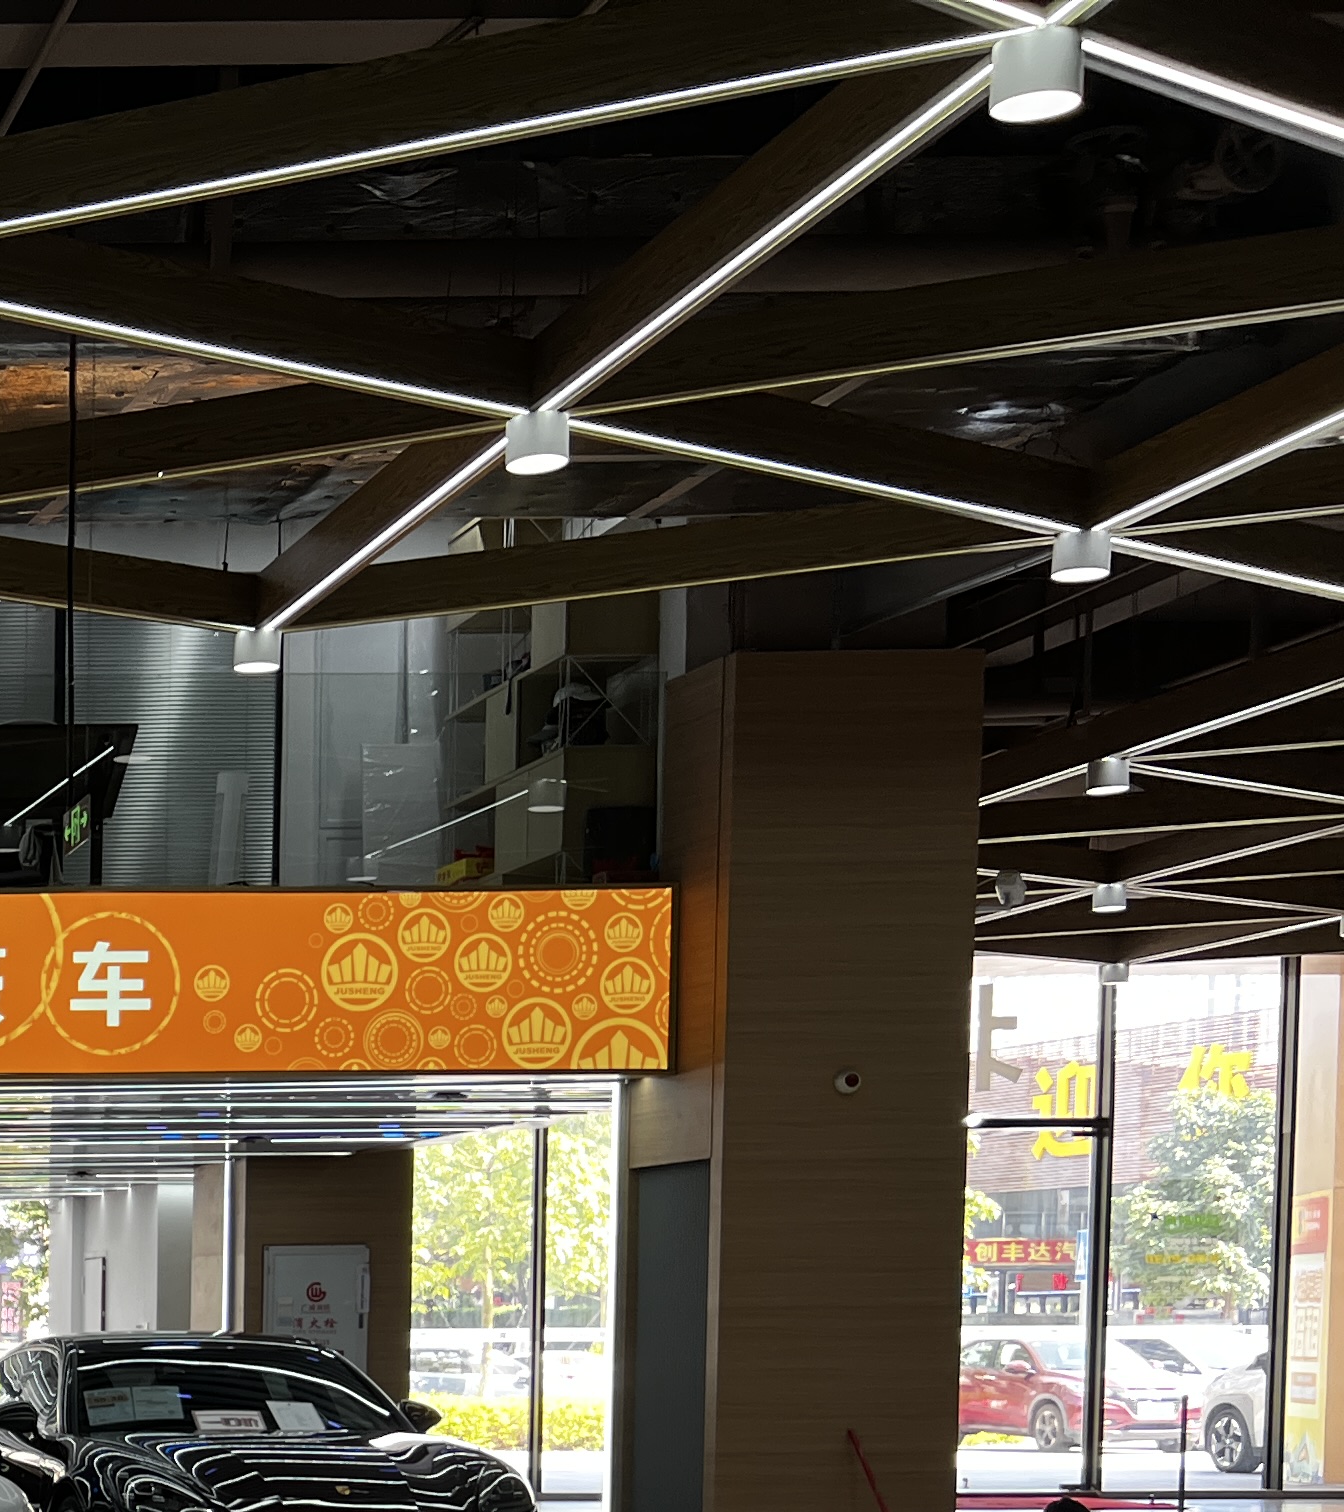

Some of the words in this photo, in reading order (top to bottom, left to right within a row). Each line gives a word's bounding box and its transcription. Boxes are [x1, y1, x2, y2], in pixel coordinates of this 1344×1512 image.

[464, 973, 503, 981] JUSHENG
[333, 987, 385, 996] JUSHENG
[513, 1047, 561, 1055] JUSHENG
[964, 1241, 1077, 1262] 创丰达汽
